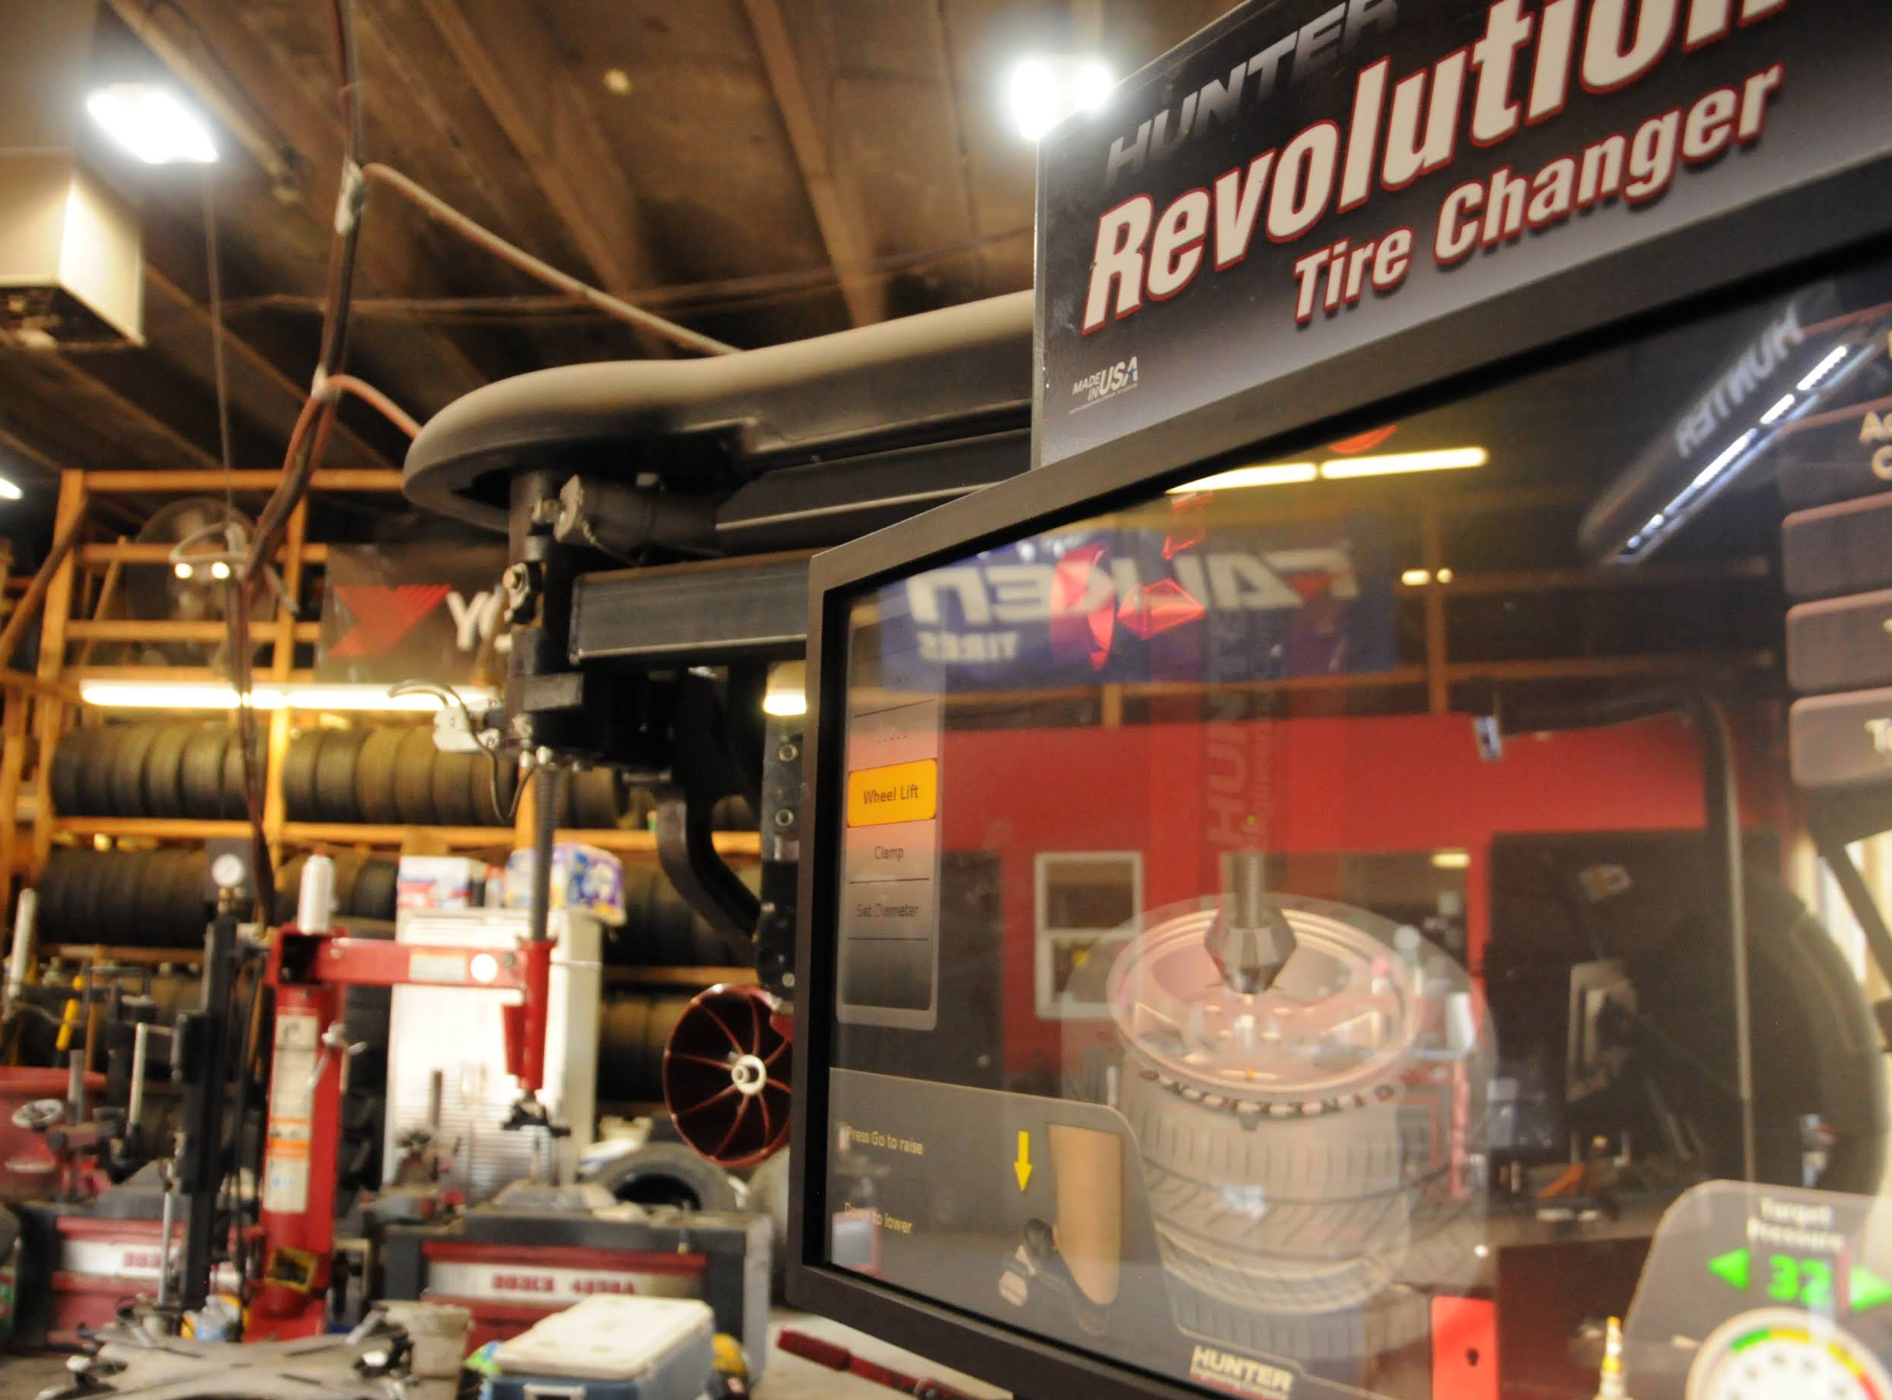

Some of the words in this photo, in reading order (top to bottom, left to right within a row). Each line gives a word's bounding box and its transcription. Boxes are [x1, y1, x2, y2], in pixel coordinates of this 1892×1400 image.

[1104, 0, 1400, 194] HUNTER
[1293, 225, 1414, 325] Tire
[1433, 61, 1785, 267] Changer
[1071, 371, 1102, 396] MADE
[1087, 386, 1100, 402] IN
[1098, 355, 1139, 396] USA
[863, 786, 897, 805] Wheel
[900, 783, 920, 802] Lift
[873, 845, 905, 862] Clamp
[856, 902, 873, 918] Set
[846, 1125, 870, 1144] Press
[871, 1130, 886, 1147] Go
[887, 1134, 898, 1150] to
[900, 1137, 924, 1156] raise
[885, 1212, 913, 1234] lower
[1766, 1252, 1831, 1308] 32
[1190, 1344, 1293, 1394] HUNTER
